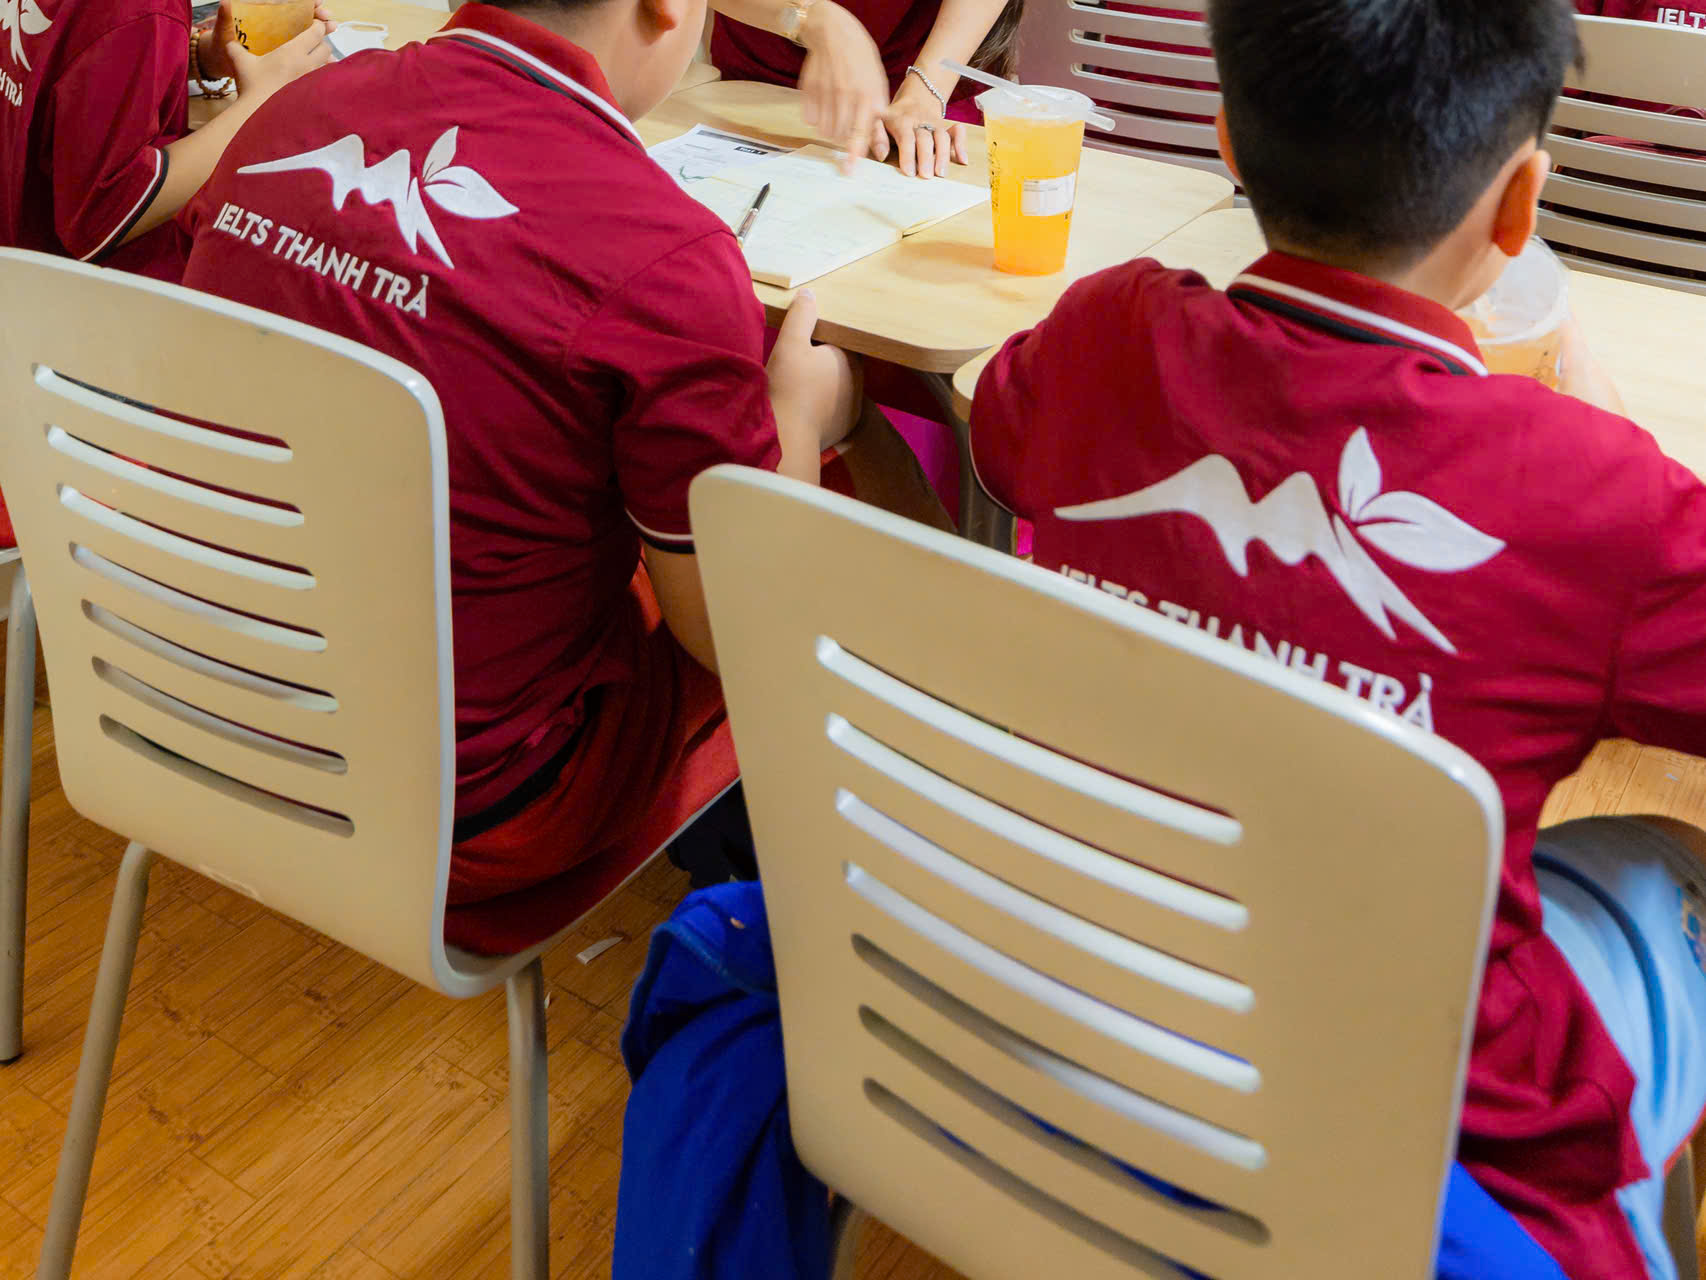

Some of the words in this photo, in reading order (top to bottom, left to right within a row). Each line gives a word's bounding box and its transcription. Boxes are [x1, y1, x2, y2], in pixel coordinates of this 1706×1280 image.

[1656, 7, 1706, 30] IELT
[212, 202, 274, 247] IELTS
[272, 225, 370, 291] THANH
[371, 266, 430, 319] TRÀ
[1338, 660, 1435, 735] TRÀ
